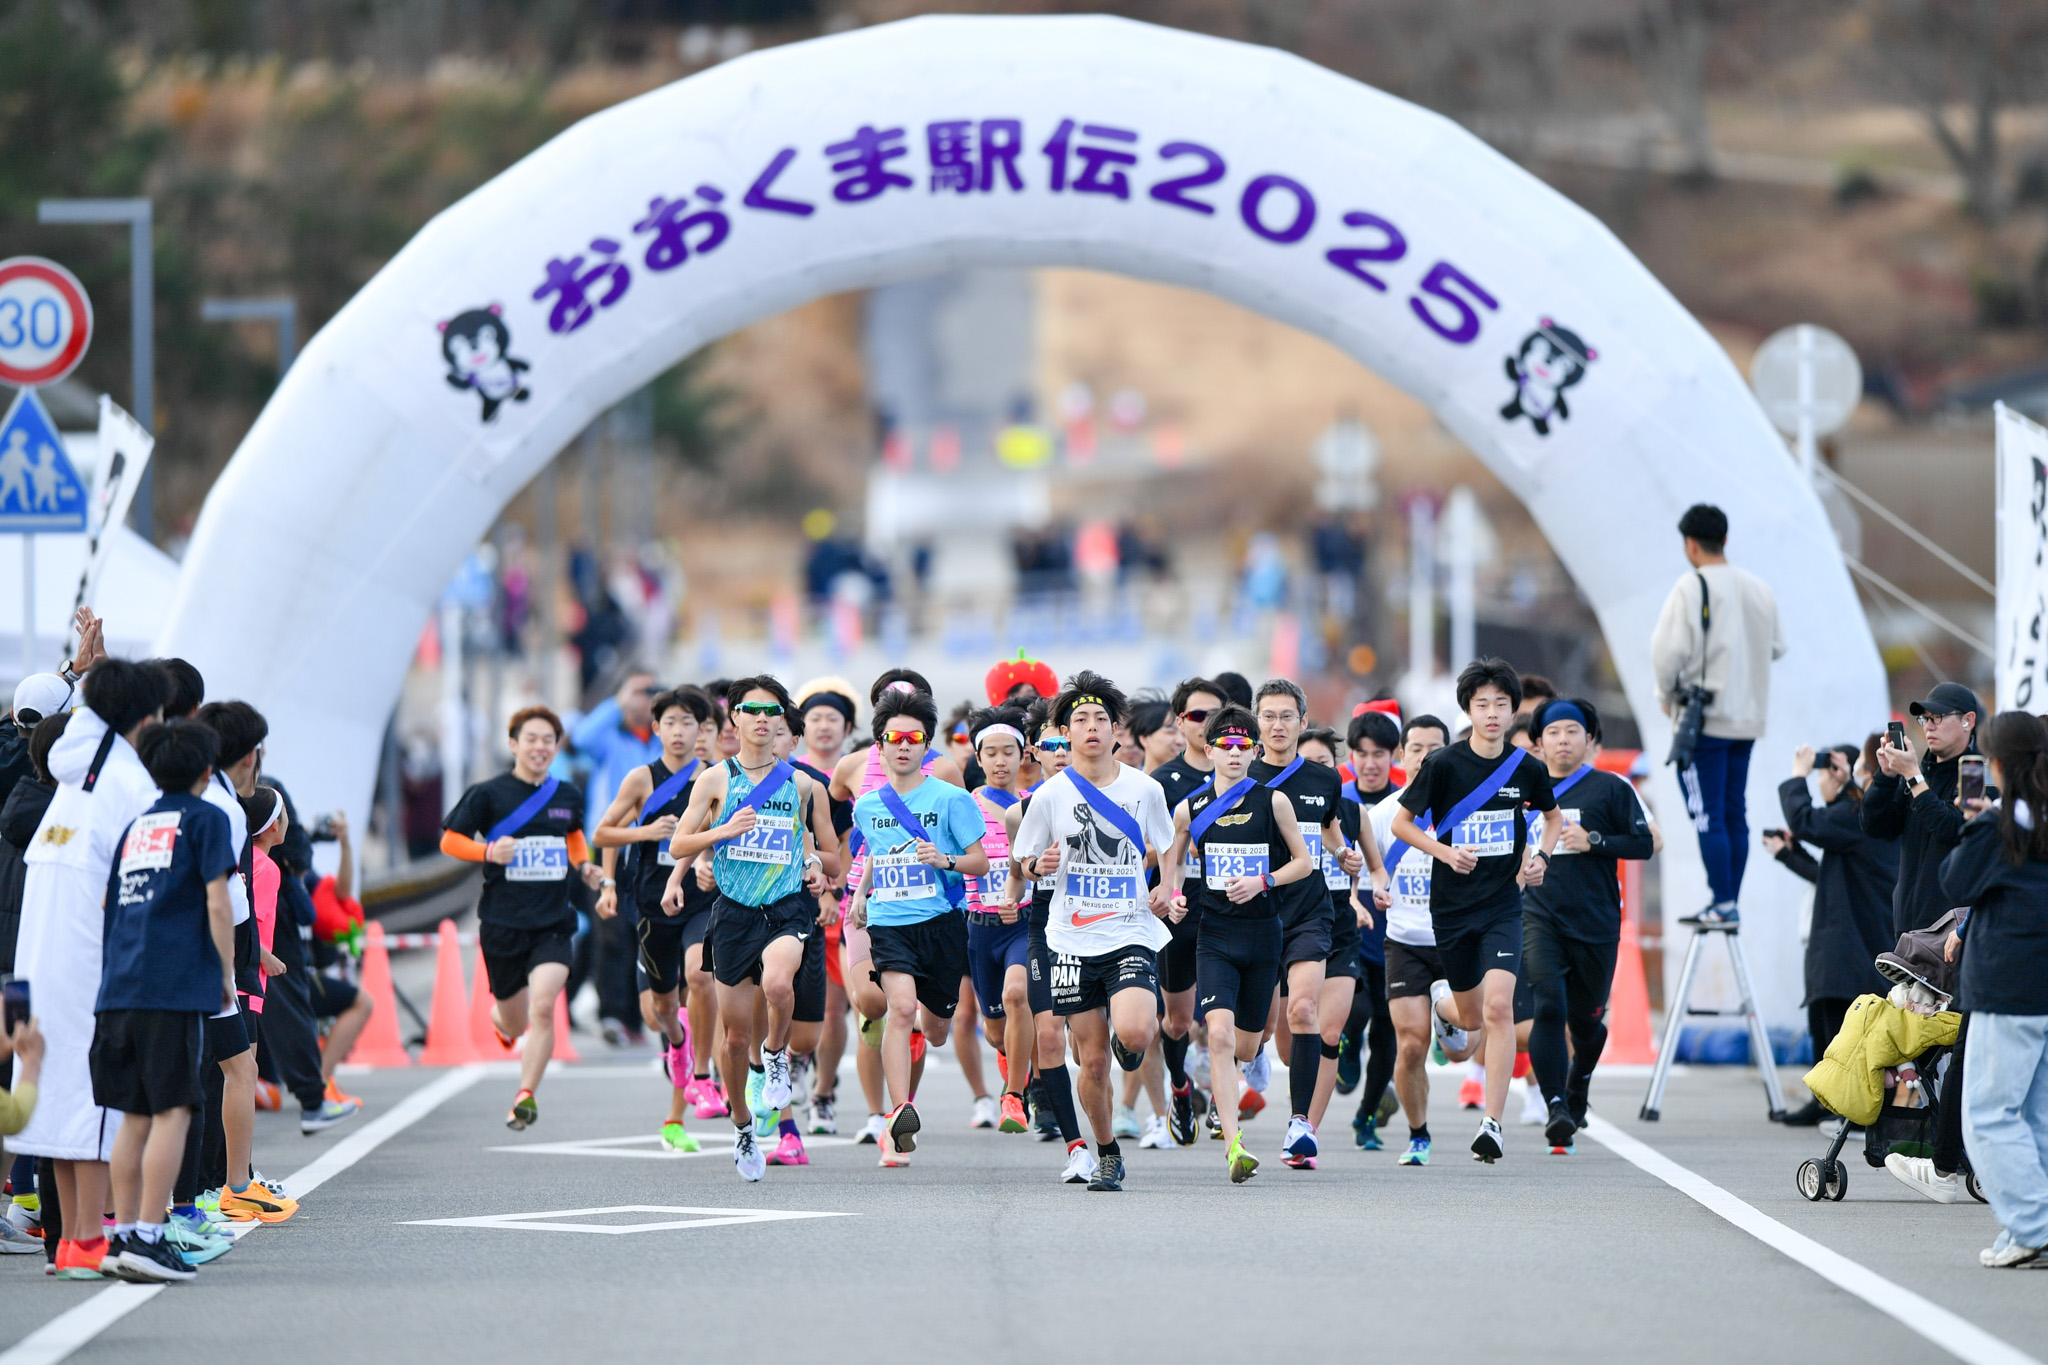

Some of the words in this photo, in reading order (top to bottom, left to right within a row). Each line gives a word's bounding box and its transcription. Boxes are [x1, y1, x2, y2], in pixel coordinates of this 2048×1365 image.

[532, 118, 1499, 344] おおくま駅伝2025
[0, 298, 60, 349] 30
[872, 817, 899, 829] Team
[1461, 823, 1507, 843] 114-1
[740, 827, 787, 851] 127-1
[515, 849, 561, 868] 112-1
[1211, 855, 1263, 877] 123-1
[879, 866, 927, 888] 101-1
[1071, 866, 1113, 875] おおくま駅伝
[1076, 876, 1127, 898] 118-1
[1057, 954, 1081, 965] ALL
